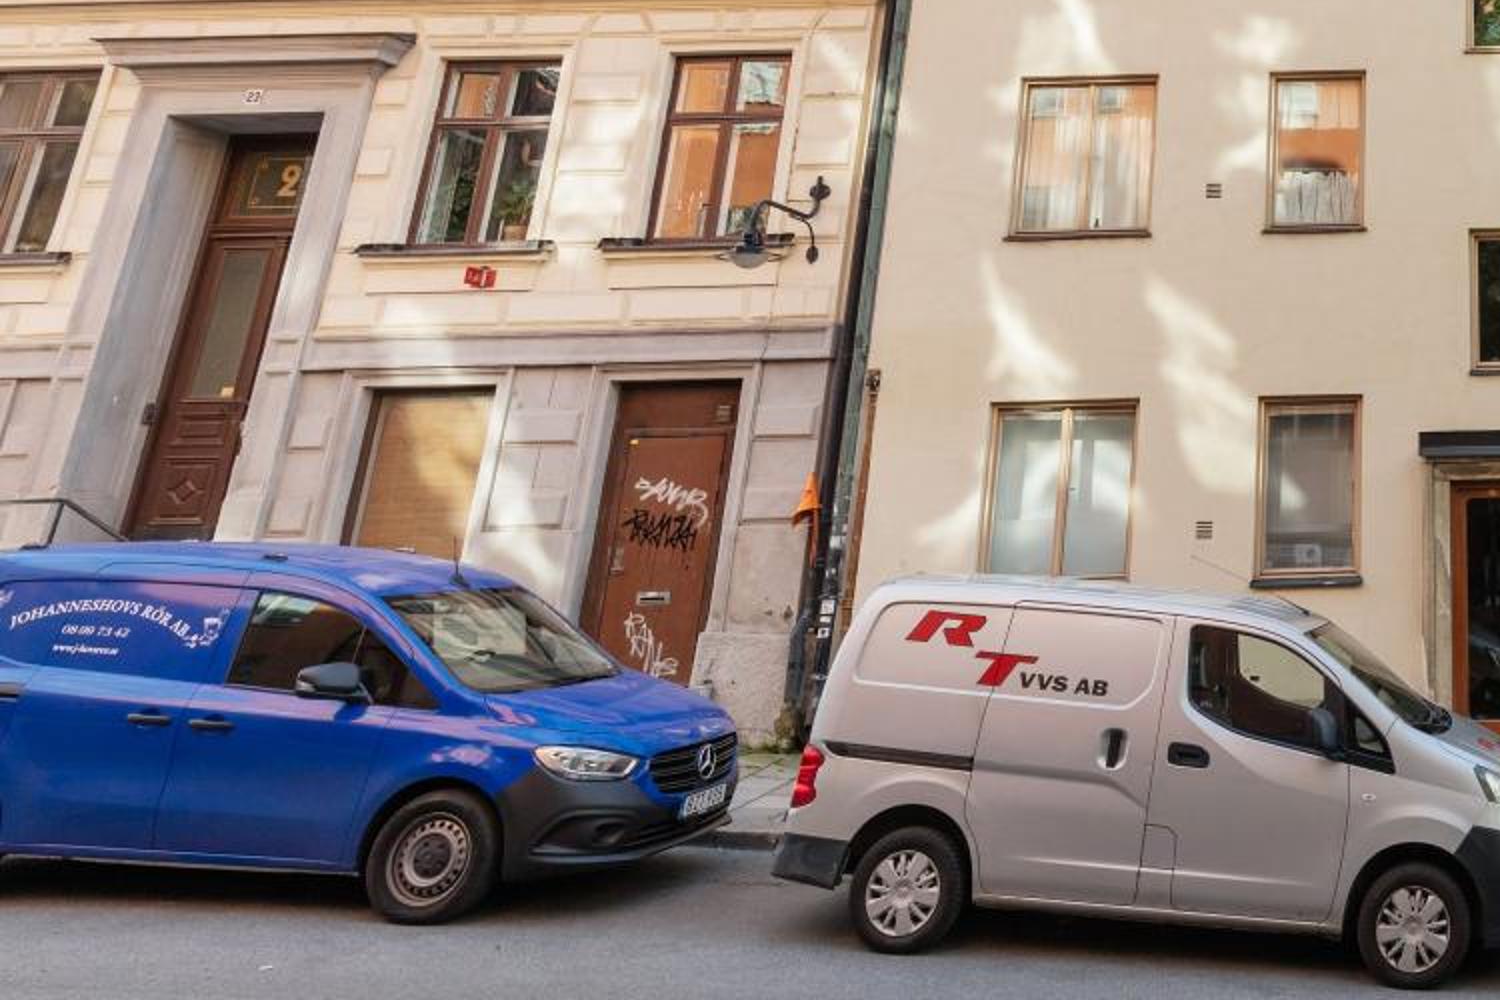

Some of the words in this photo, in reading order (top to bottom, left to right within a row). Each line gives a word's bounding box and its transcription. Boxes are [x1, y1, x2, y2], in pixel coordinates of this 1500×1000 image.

[9, 599, 142, 630] JOHANNESHOVS
[169, 619, 191, 637] AB
[1019, 671, 1068, 693] VVS
[1074, 678, 1109, 697] AB
